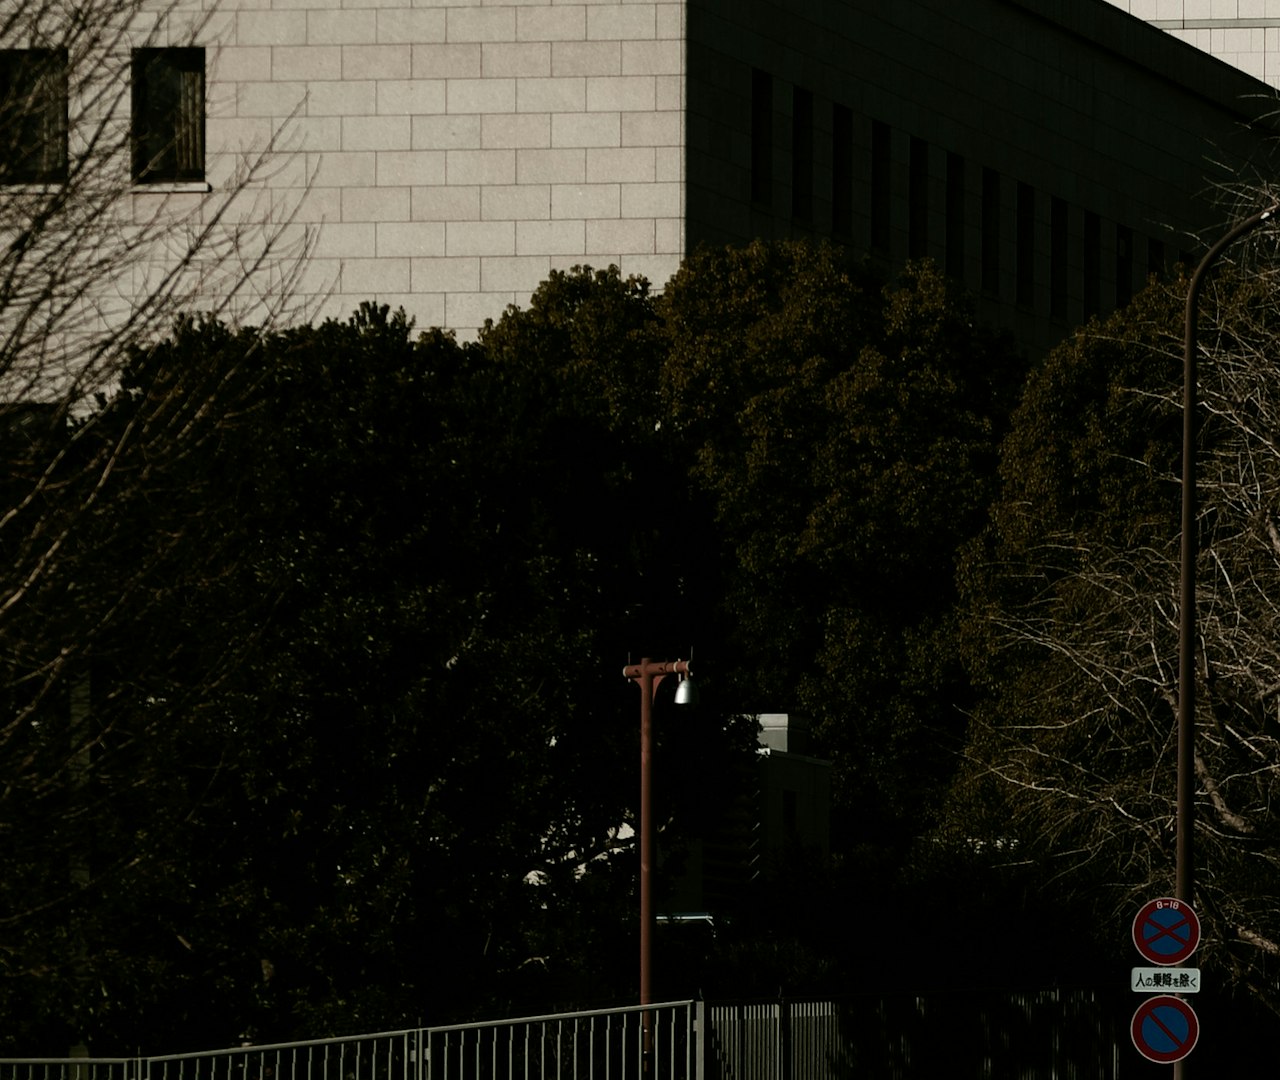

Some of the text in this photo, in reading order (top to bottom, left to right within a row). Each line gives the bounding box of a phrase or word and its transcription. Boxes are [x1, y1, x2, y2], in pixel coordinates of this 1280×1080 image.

[1156, 900, 1180, 910] 8-18
[1135, 973, 1197, 988] 人の乗降を除く
